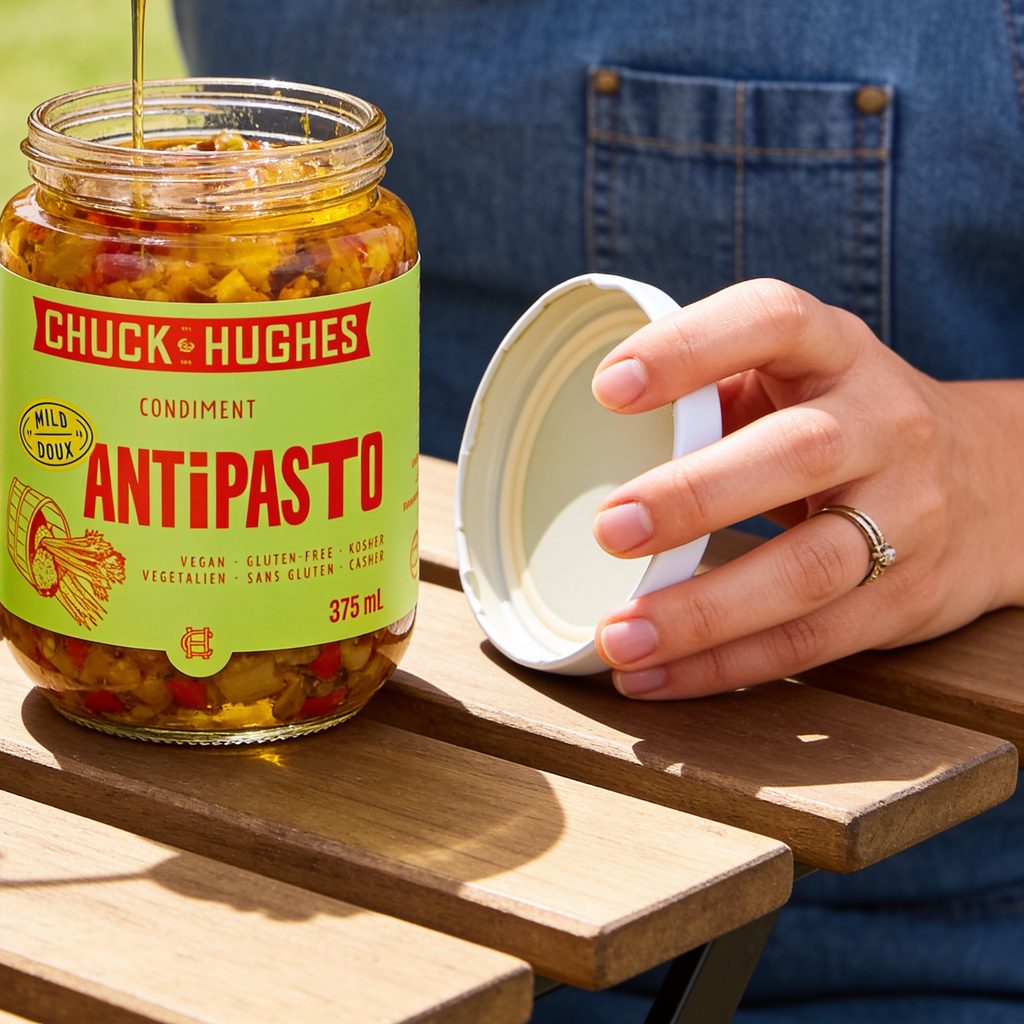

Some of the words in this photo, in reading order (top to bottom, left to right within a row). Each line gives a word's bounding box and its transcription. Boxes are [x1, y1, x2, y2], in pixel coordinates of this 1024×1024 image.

[44, 309, 172, 365] CHUCK
[205, 313, 358, 366] HUGHES
[34, 408, 68, 430] MILD
[139, 397, 256, 420] CONDIMENT
[37, 441, 74, 460] DOUX
[142, 569, 226, 585] VEGETALIEN
[247, 571, 280, 584] SANS
[287, 562, 334, 581] GLUTEN
[348, 549, 385, 571] CASHER
[180, 555, 225, 568] VEGAN
[246, 546, 334, 568] GLUTEN-FREE
[348, 533, 385, 554] KOSHER
[328, 594, 360, 623] 375
[363, 587, 384, 615] mL
